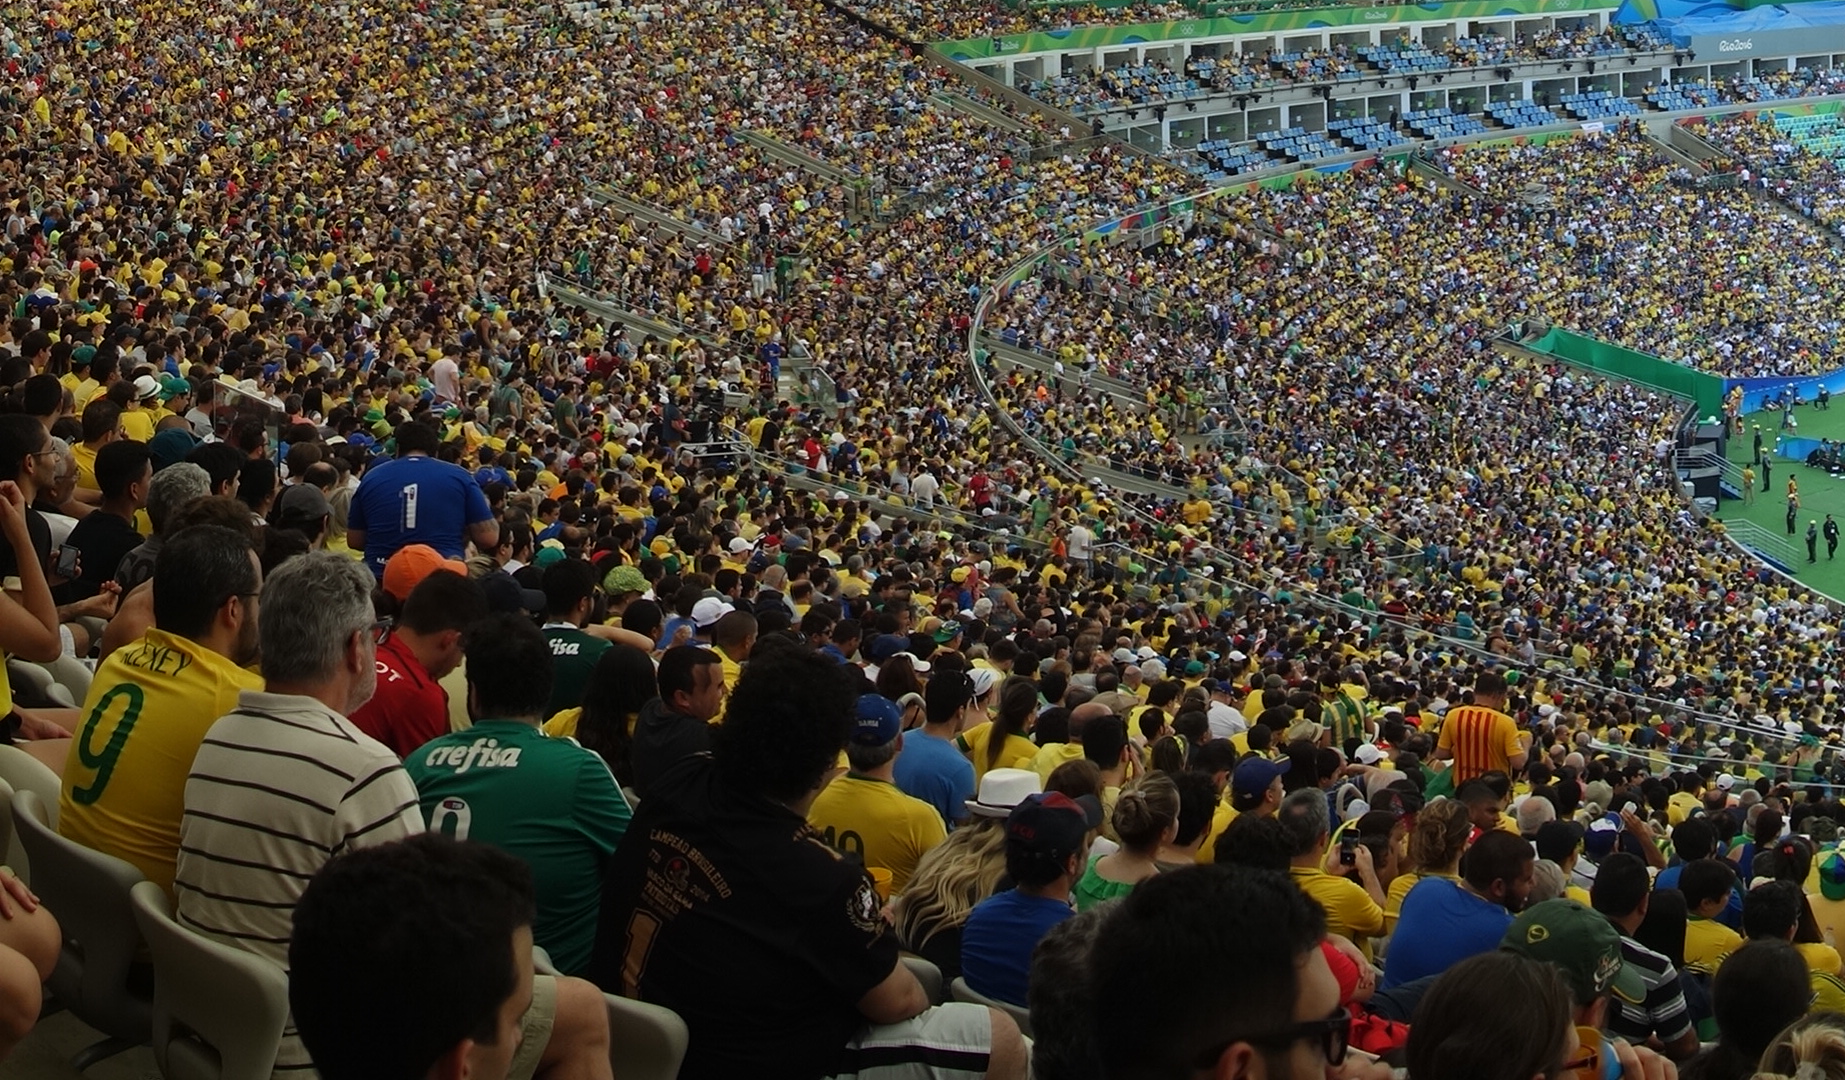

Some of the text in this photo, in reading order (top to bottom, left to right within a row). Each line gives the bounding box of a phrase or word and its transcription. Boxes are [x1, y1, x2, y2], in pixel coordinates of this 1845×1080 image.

[1719, 38, 1753, 52] Rio2016
[403, 483, 418, 529] 1
[73, 683, 145, 806] 9
[426, 737, 522, 775] crefisa
[618, 908, 664, 1001] 1
